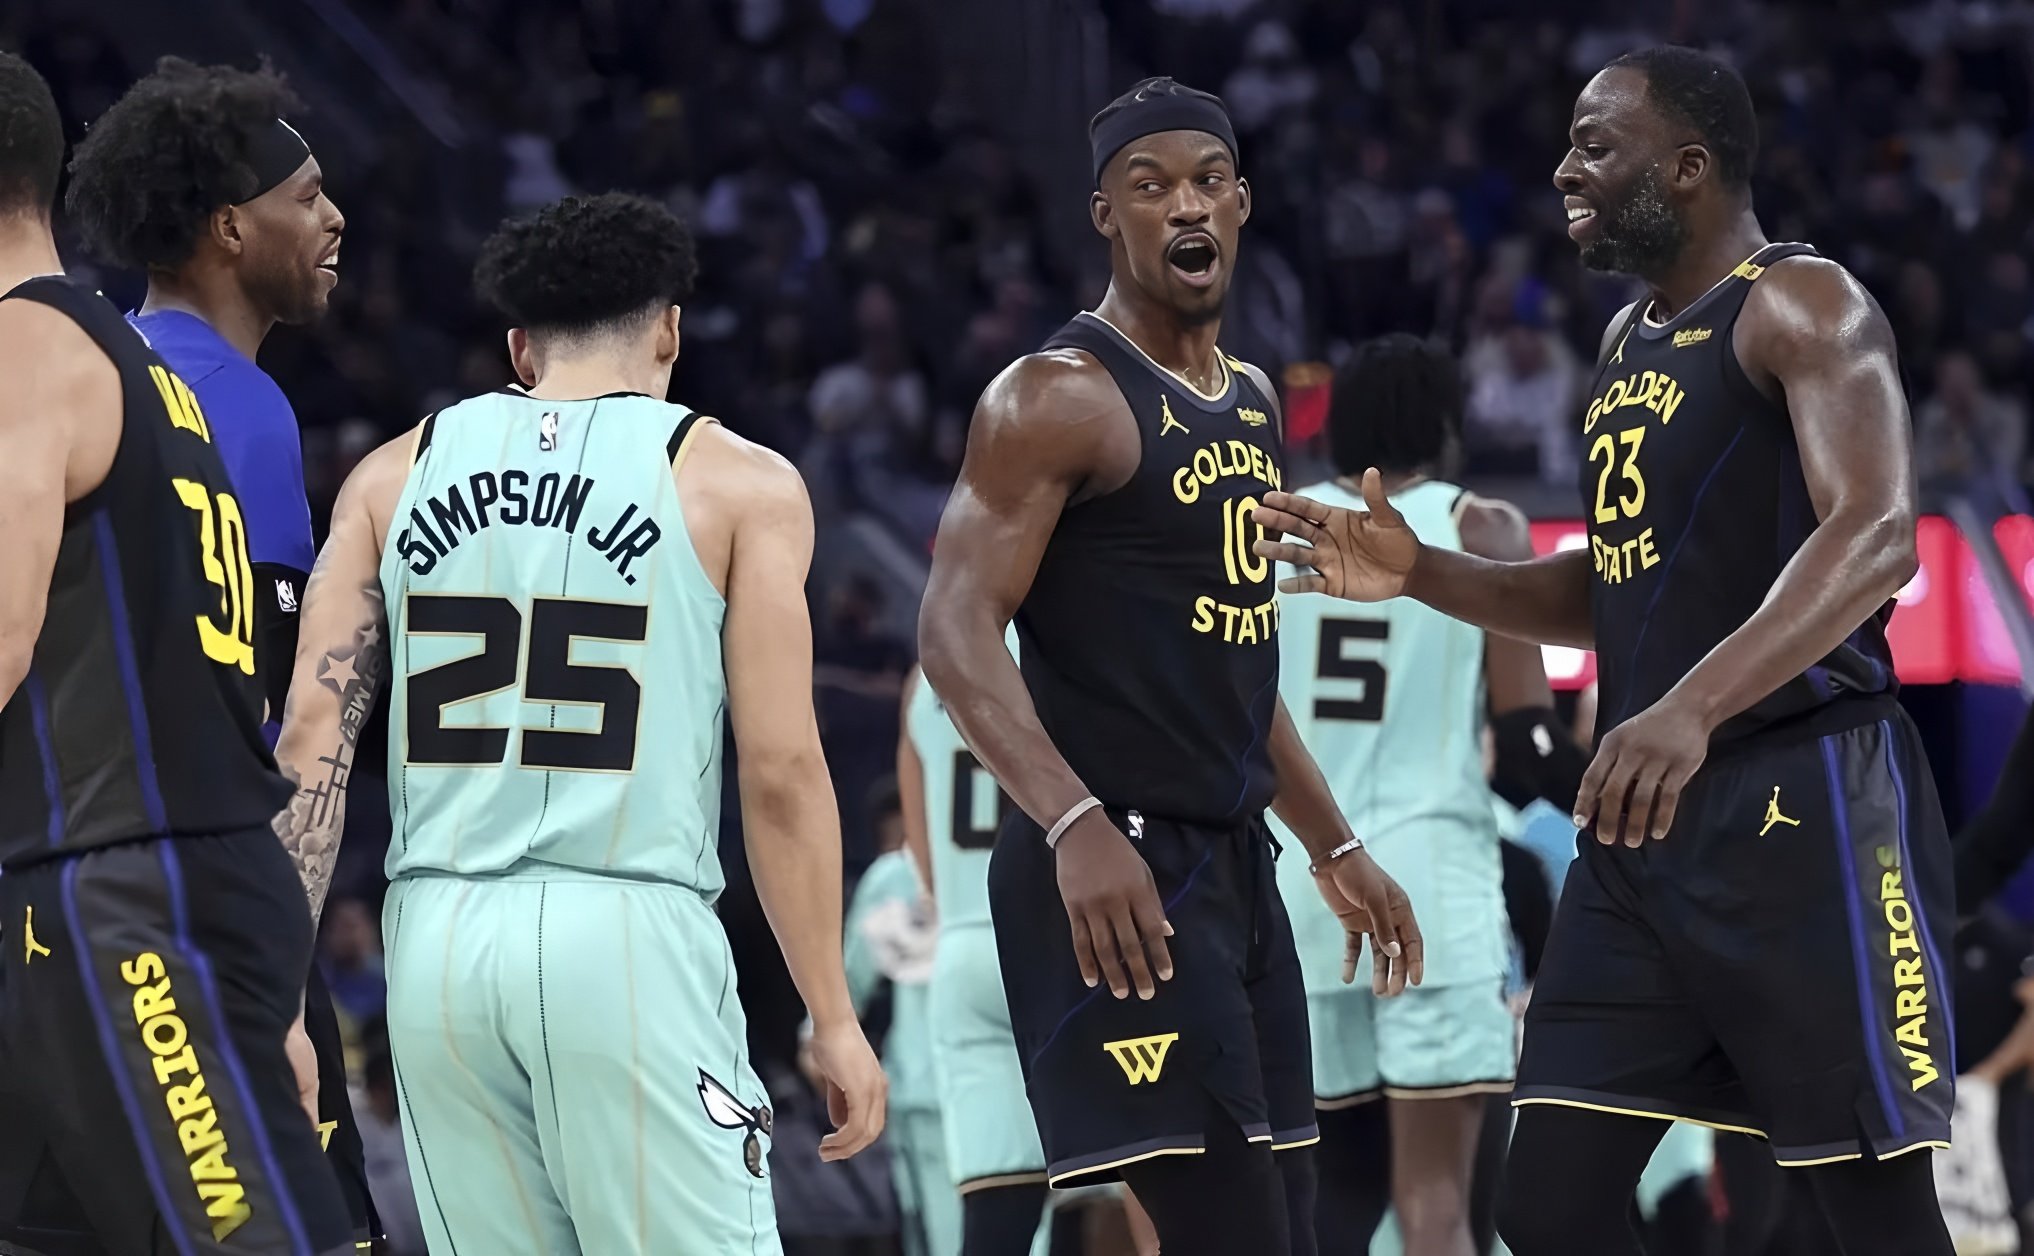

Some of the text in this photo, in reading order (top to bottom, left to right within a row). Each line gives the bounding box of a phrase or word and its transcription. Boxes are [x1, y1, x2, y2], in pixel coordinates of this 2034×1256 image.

[1583, 370, 1685, 434] GOLDEN
[1172, 440, 1282, 504] GOLDEN
[1588, 425, 1646, 524] 23
[396, 469, 662, 587] SIMPSON JR.
[1222, 495, 1268, 585] 10
[1592, 527, 1661, 584] STATE
[405, 592, 650, 776] 25
[1313, 615, 1391, 723] 5
[120, 952, 253, 1243] WARRIORS
